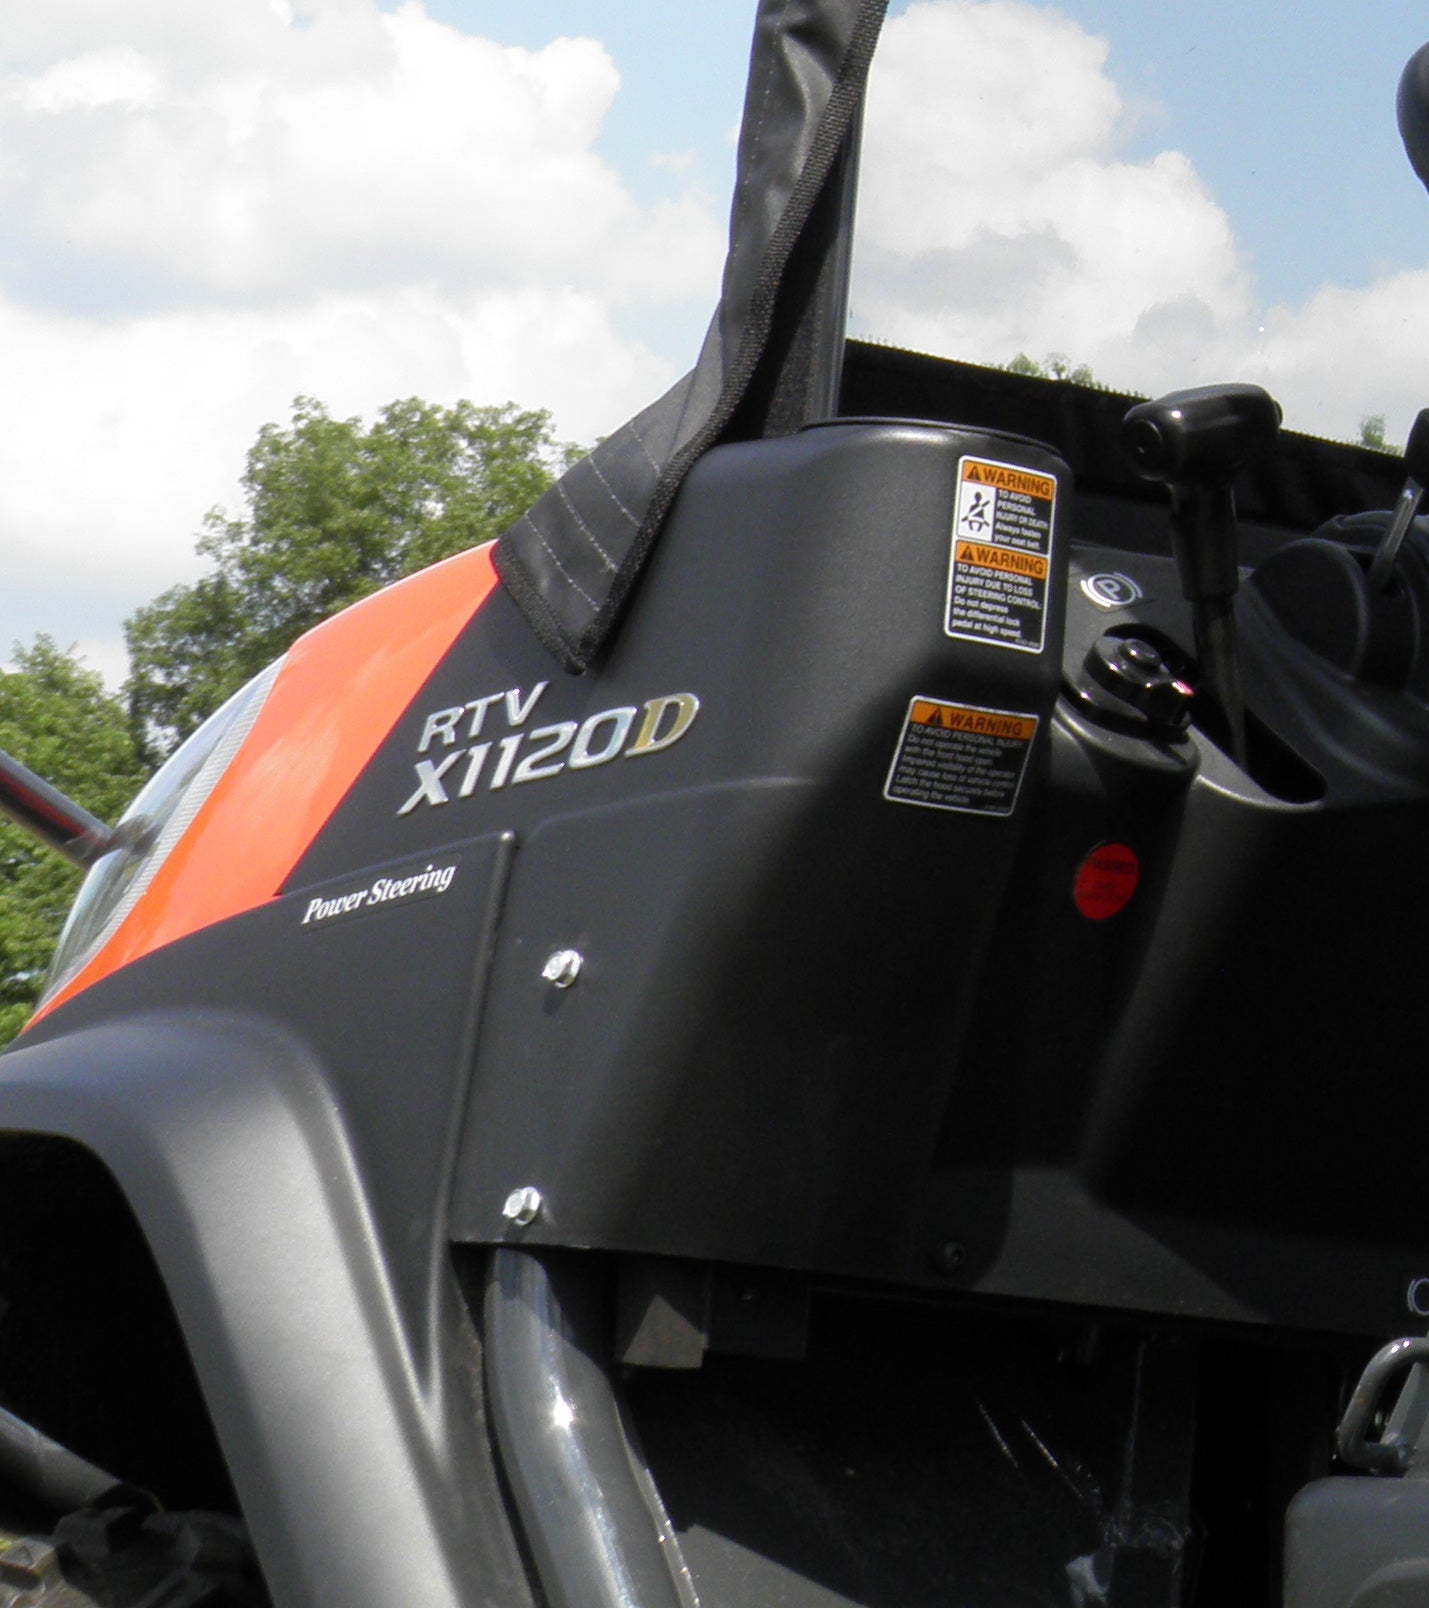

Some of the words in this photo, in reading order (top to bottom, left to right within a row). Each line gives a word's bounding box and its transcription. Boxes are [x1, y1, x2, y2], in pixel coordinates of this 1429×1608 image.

[983, 467, 1050, 496] WARNING
[975, 546, 1044, 574] WARNING
[957, 563, 969, 572] TO
[969, 565, 993, 577] AVOID
[994, 570, 1033, 586] PERSONAL
[1003, 582, 1013, 592] TO
[955, 584, 967, 594] OF
[417, 680, 549, 753] RTV
[950, 711, 1024, 736] WARNING
[396, 692, 701, 817] X1120D
[302, 888, 368, 924] Power
[367, 864, 457, 906] Steering
